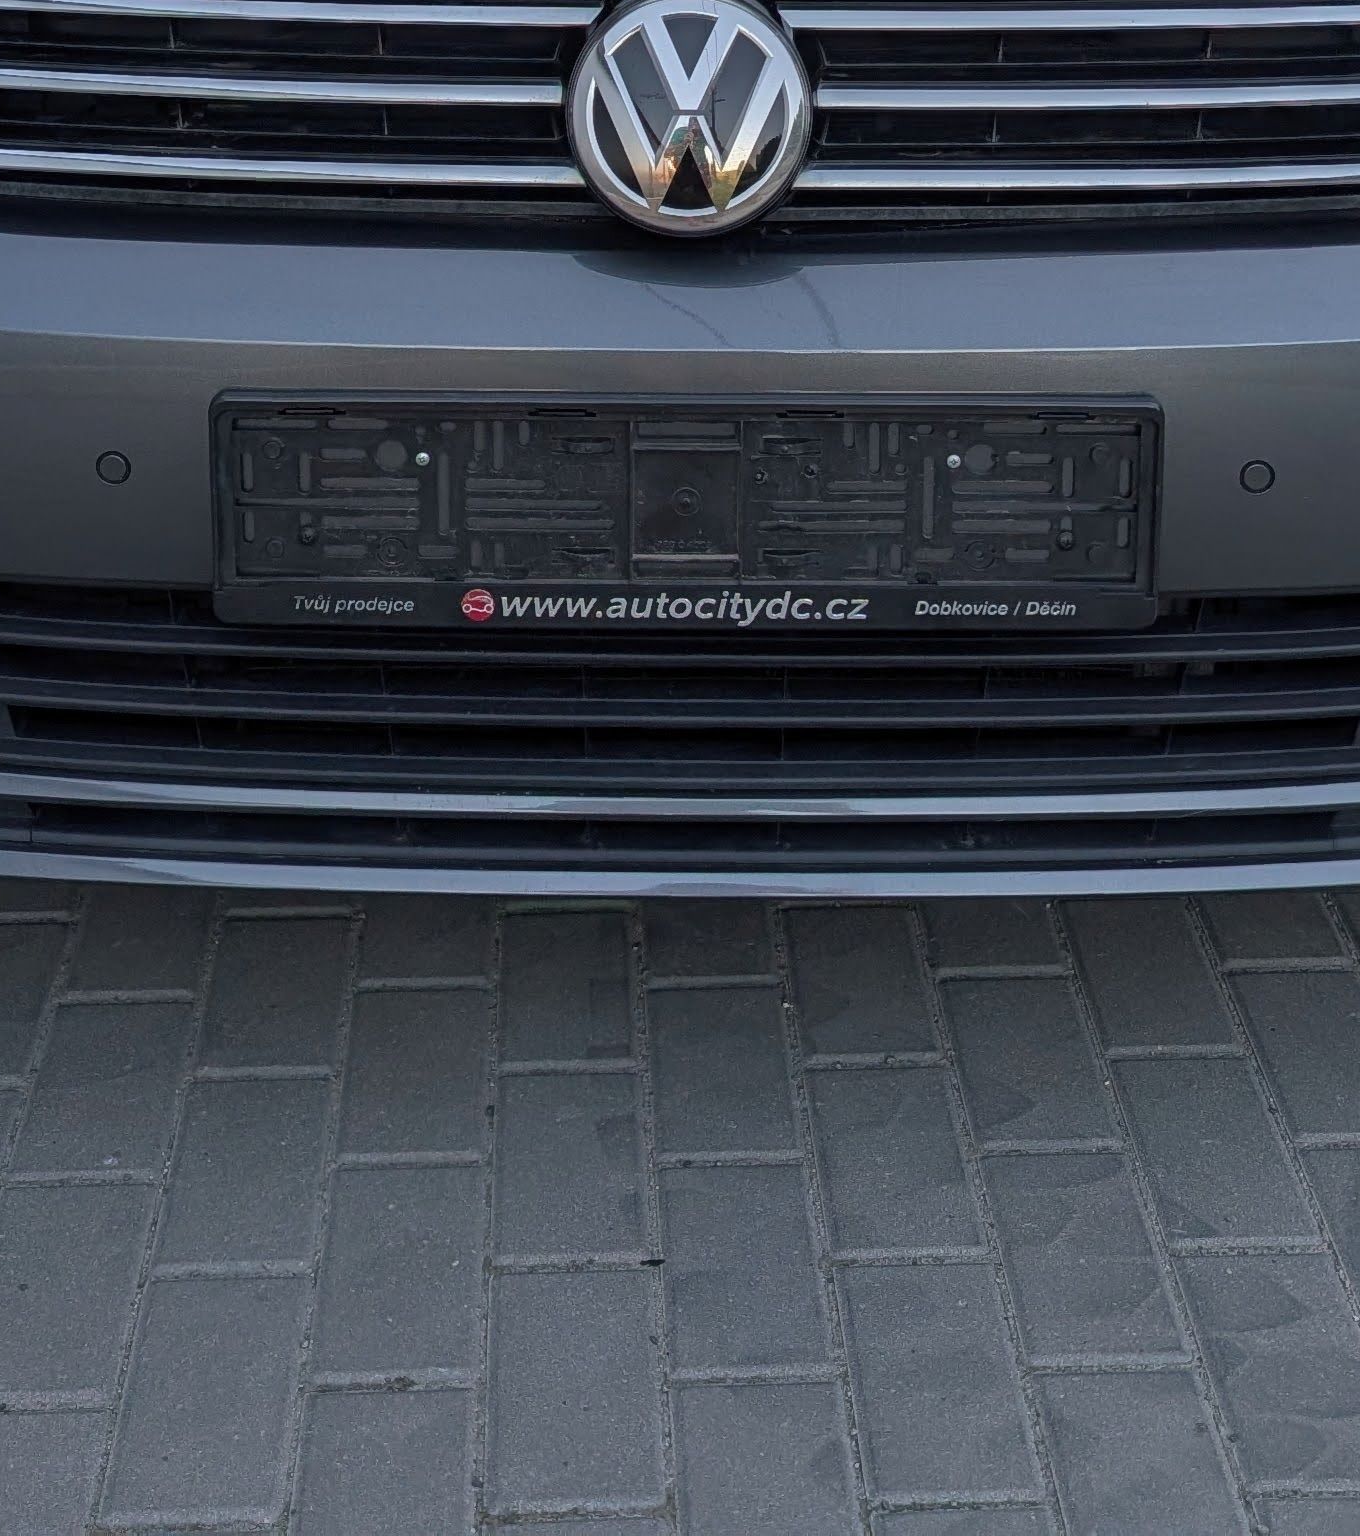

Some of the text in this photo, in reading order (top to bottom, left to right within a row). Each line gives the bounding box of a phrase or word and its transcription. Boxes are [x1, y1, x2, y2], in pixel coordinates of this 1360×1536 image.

[294, 595, 332, 614] Tvůj
[334, 596, 415, 615] prodejce
[500, 590, 870, 627] www.autocitydc.cz
[914, 600, 1009, 616] Dobkovice
[1012, 601, 1022, 616] /
